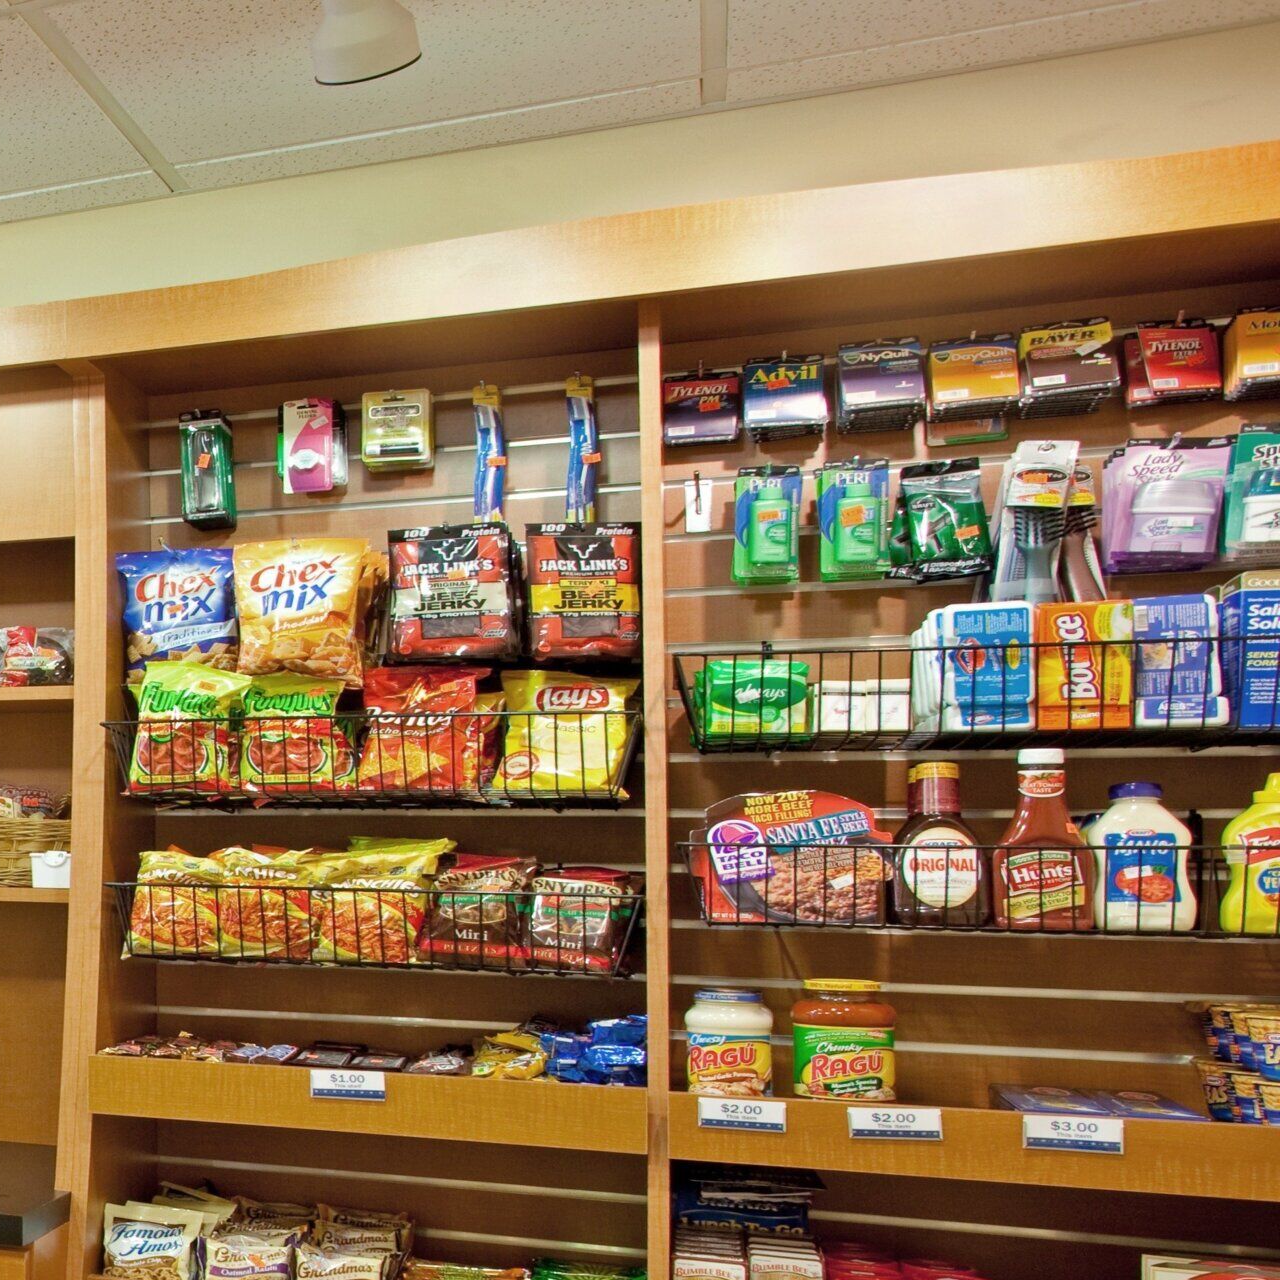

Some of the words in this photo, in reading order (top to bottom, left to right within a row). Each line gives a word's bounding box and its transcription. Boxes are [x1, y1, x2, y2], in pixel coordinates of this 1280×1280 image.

[1030, 330, 1095, 346] BAYER
[1149, 340, 1202, 352] TYLENOL
[860, 350, 910, 363] NyQuil
[951, 347, 1010, 362] DayQuil
[749, 365, 818, 384] Advil
[670, 384, 729, 398] TYLENOL
[1143, 452, 1182, 468] Lady
[1128, 462, 1183, 479] Speed
[461, 527, 500, 538] Protein
[595, 526, 633, 536] Protein
[404, 562, 442, 576] JACK
[443, 559, 494, 573] LINK'S
[541, 560, 578, 572] JACK
[580, 557, 628, 571] LINK'S
[250, 555, 342, 593] Chex
[136, 565, 221, 603] Chex
[262, 576, 335, 616] mix
[421, 590, 479, 601] BEEF
[561, 590, 617, 599] BEEF
[144, 588, 217, 622] mix
[414, 599, 487, 611] JERKY
[554, 599, 623, 610] JERKY
[545, 721, 597, 734] Classic
[745, 794, 775, 806] NOW
[777, 791, 809, 803] 20%
[744, 803, 782, 816] MORE
[783, 799, 813, 811] BEEF
[751, 814, 773, 823] TACO
[775, 809, 812, 822] FILLING!
[840, 811, 866, 822] STYLE
[766, 822, 818, 845] SANTA
[820, 816, 840, 835] FE
[841, 819, 868, 833] BEEF
[719, 851, 763, 863] TACO
[722, 859, 766, 871] BELL
[909, 858, 976, 873] ORIGNAL
[533, 879, 621, 896] SNYDER'S
[545, 937, 582, 950] Mini
[690, 1033, 726, 1046] Cheesy
[816, 1042, 864, 1055] Chunky
[329, 1073, 366, 1085] $1.00
[721, 1102, 763, 1116] $2.00
[871, 1112, 916, 1125] $2.00
[1050, 1120, 1099, 1134] $3.00
[112, 1221, 183, 1240] Famous
[119, 1238, 183, 1257] Amos
[221, 1267, 252, 1276] Oatmeal
[254, 1264, 278, 1274] Raisin
